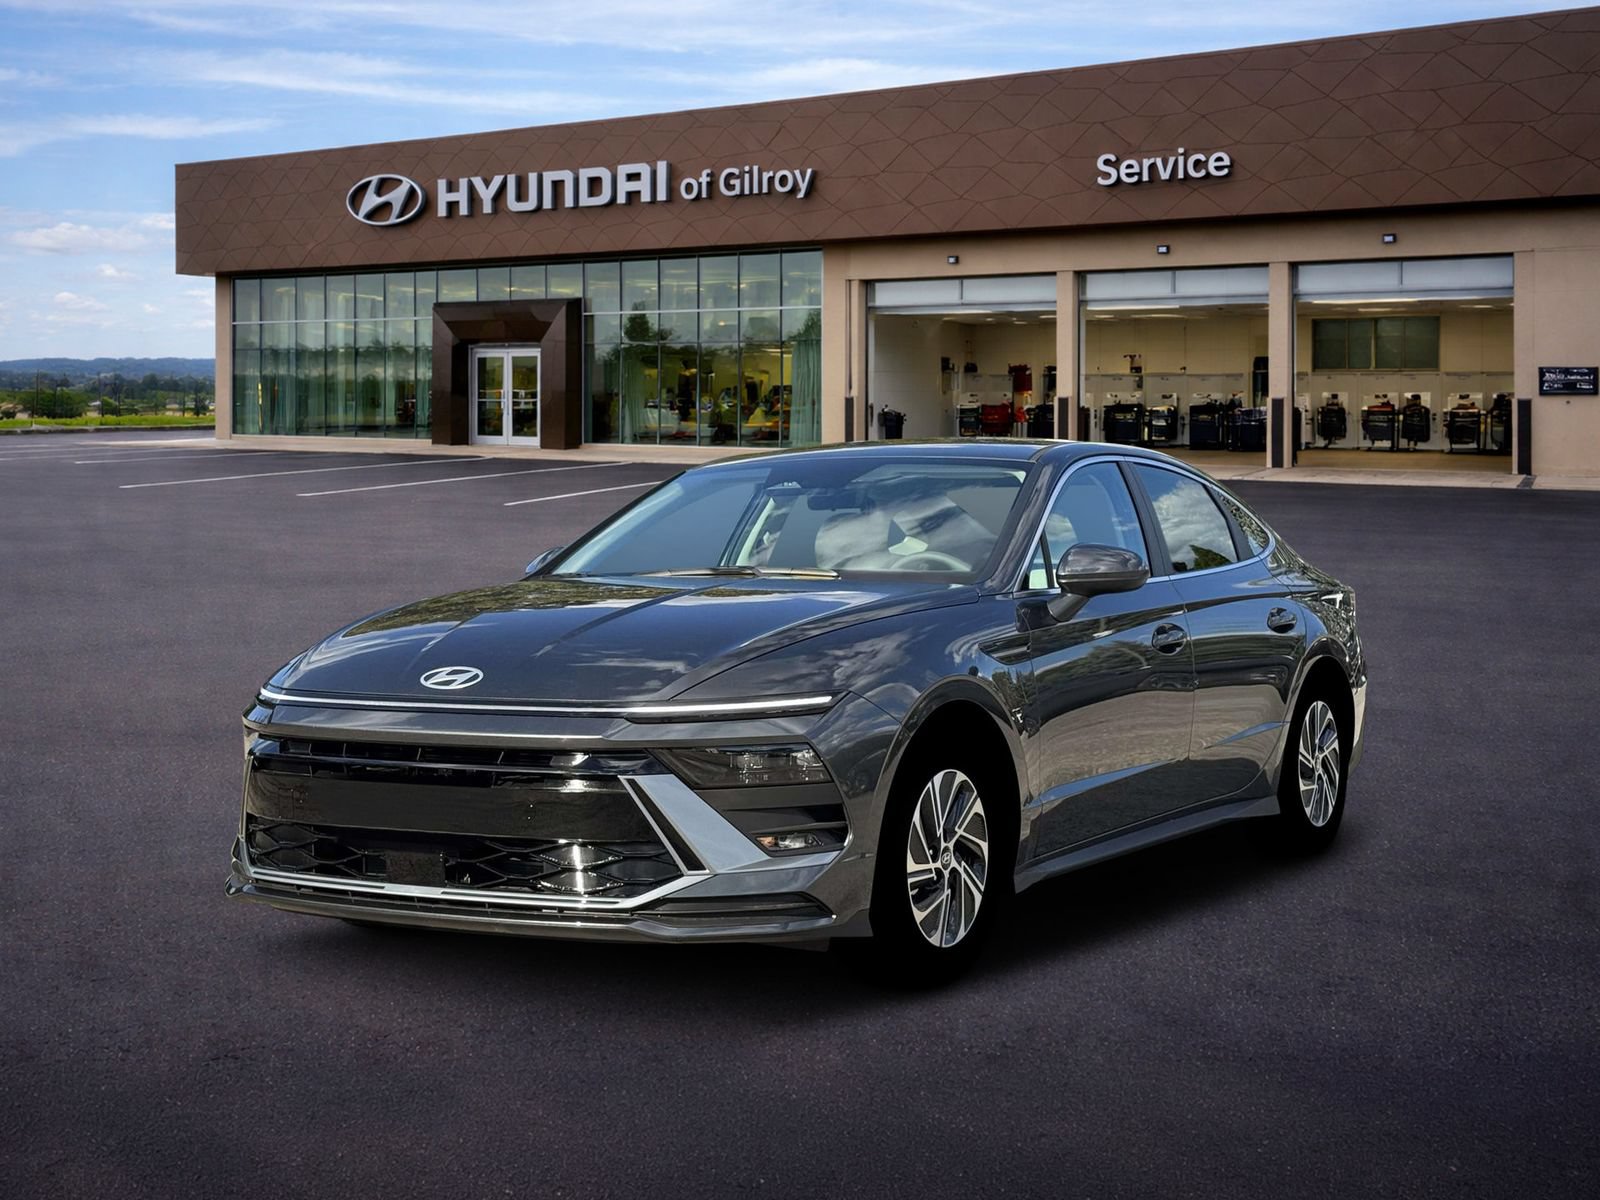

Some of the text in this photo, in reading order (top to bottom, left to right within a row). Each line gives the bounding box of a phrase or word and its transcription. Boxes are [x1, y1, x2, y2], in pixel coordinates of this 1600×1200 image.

[437, 160, 668, 217] HYUNDAI
[680, 169, 710, 200] of
[718, 165, 813, 198] Gilroy
[1096, 147, 1231, 186] Service
